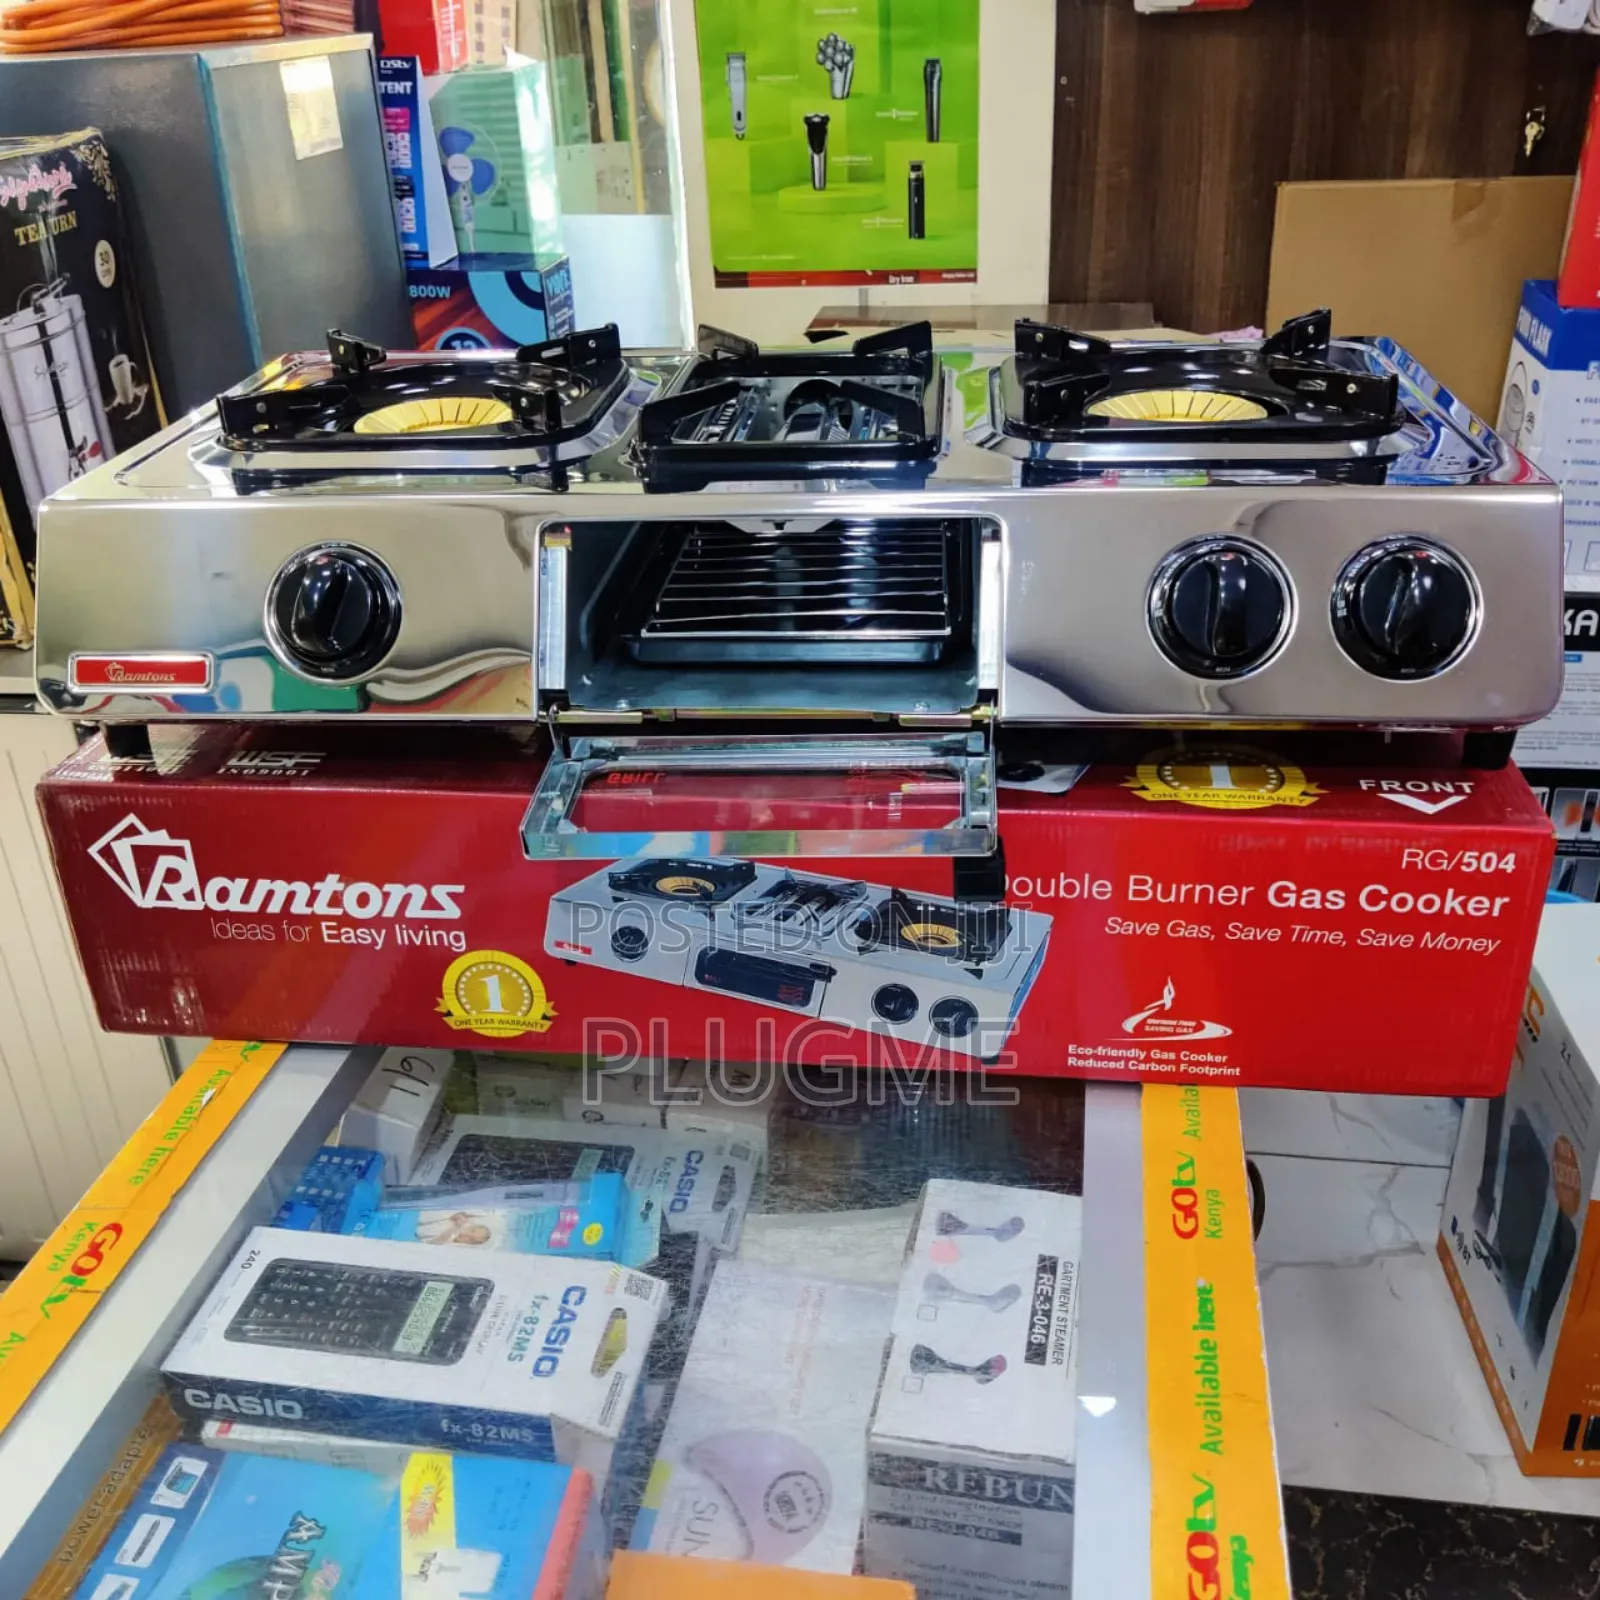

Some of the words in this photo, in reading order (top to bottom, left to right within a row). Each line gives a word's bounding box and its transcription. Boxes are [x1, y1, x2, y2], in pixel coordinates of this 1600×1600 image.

[14, 222, 50, 246] TEA
[50, 211, 78, 236] URN
[1151, 791, 1181, 799] ONE
[1185, 791, 1222, 800] YEAR
[1360, 779, 1475, 796] FRONT
[1400, 848, 1516, 875] RG/504
[144, 855, 466, 920] Ramtons
[1127, 875, 1255, 907] Burner
[1266, 880, 1346, 911] Gas
[1358, 884, 1510, 918] Cooker
[210, 916, 276, 943] Ideas
[281, 918, 311, 943] for
[320, 921, 386, 950] Easy
[395, 924, 467, 952] living
[1104, 917, 1160, 938] Save
[1166, 920, 1215, 942] Gas,
[1224, 922, 1282, 944] Save
[1289, 925, 1347, 948] Time,
[1356, 928, 1413, 950] Save
[1419, 931, 1501, 957] Money
[1067, 1057, 1125, 1070] Reduced
[1128, 1061, 1176, 1073] Carbon
[1179, 1064, 1241, 1077] Footprint
[1068, 1044, 1147, 1060] Eco-friendly
[1150, 1049, 1176, 1060] Gas
[1180, 1051, 1228, 1063] Cooker
[128, 1147, 175, 1187] here
[668, 1150, 705, 1213] CASIO
[1204, 1189, 1226, 1240] Kenya
[47, 1221, 99, 1273] Kenya
[240, 1249, 261, 1270] 240
[507, 1294, 550, 1363] fx-82MS
[1030, 1273, 1054, 1345] RE-3-046
[532, 1285, 587, 1378] CASIO
[1051, 1315, 1069, 1366] STEAMER
[183, 1388, 303, 1421] CASIO
[1193, 1338, 1224, 1456] Available
[440, 1418, 535, 1444] fx-82MS
